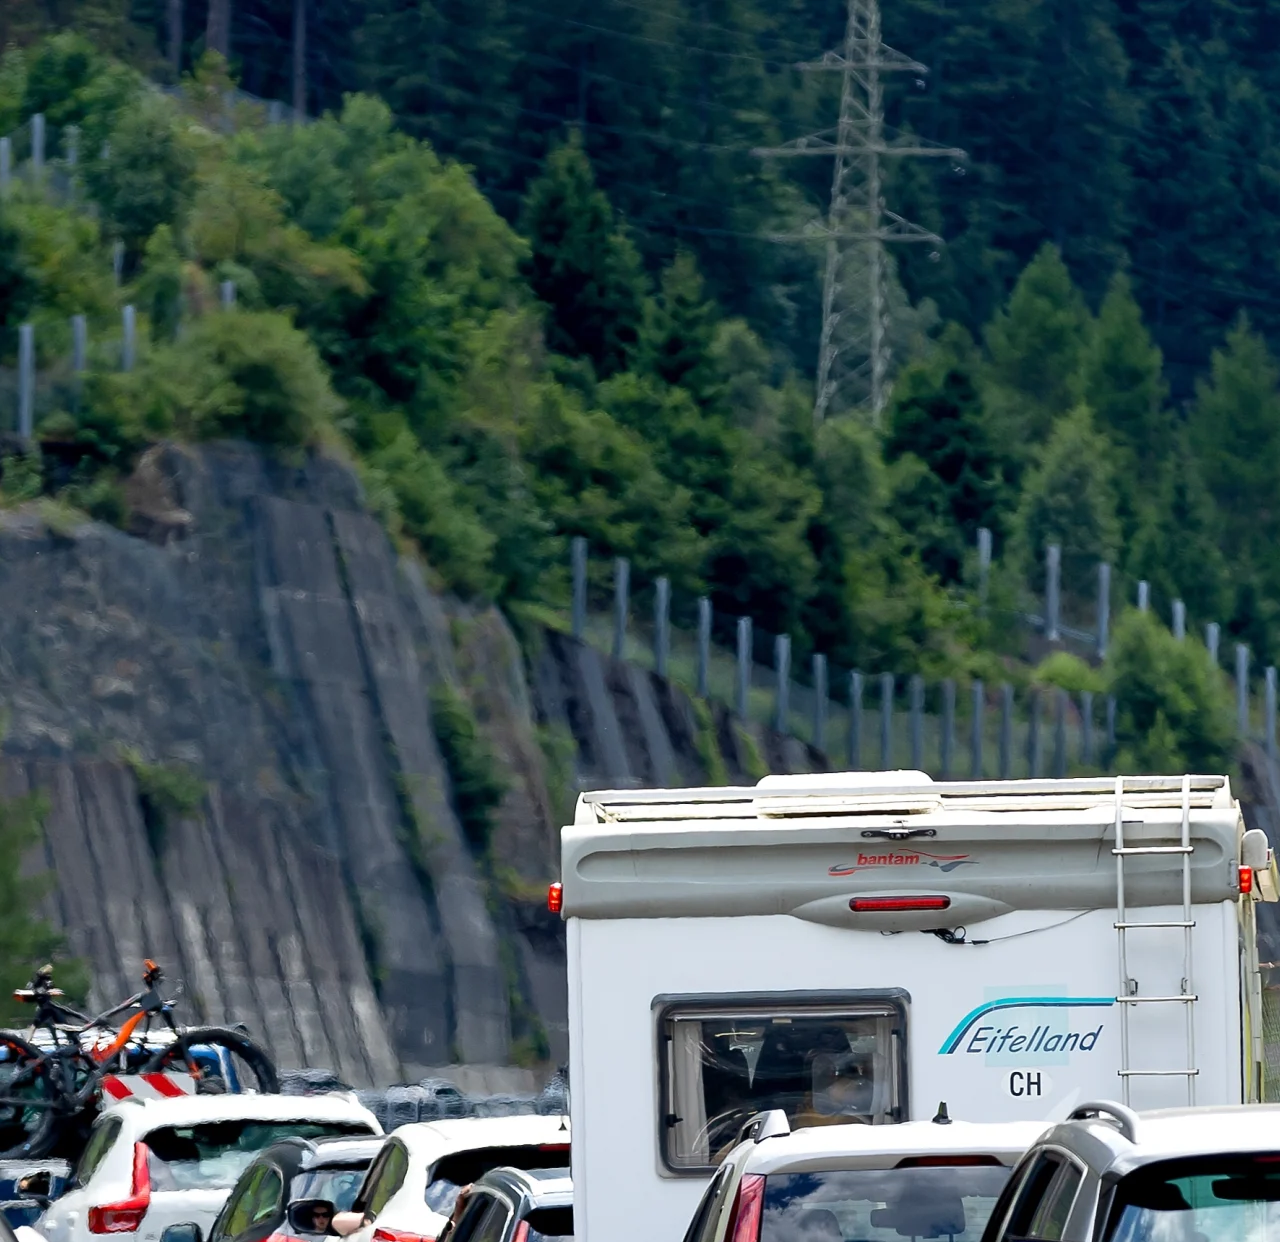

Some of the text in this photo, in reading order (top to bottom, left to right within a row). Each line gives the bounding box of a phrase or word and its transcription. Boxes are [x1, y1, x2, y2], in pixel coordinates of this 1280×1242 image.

[857, 853, 920, 866] bantam
[966, 1024, 1104, 1053] Eifelland
[1009, 1071, 1042, 1096] CH
